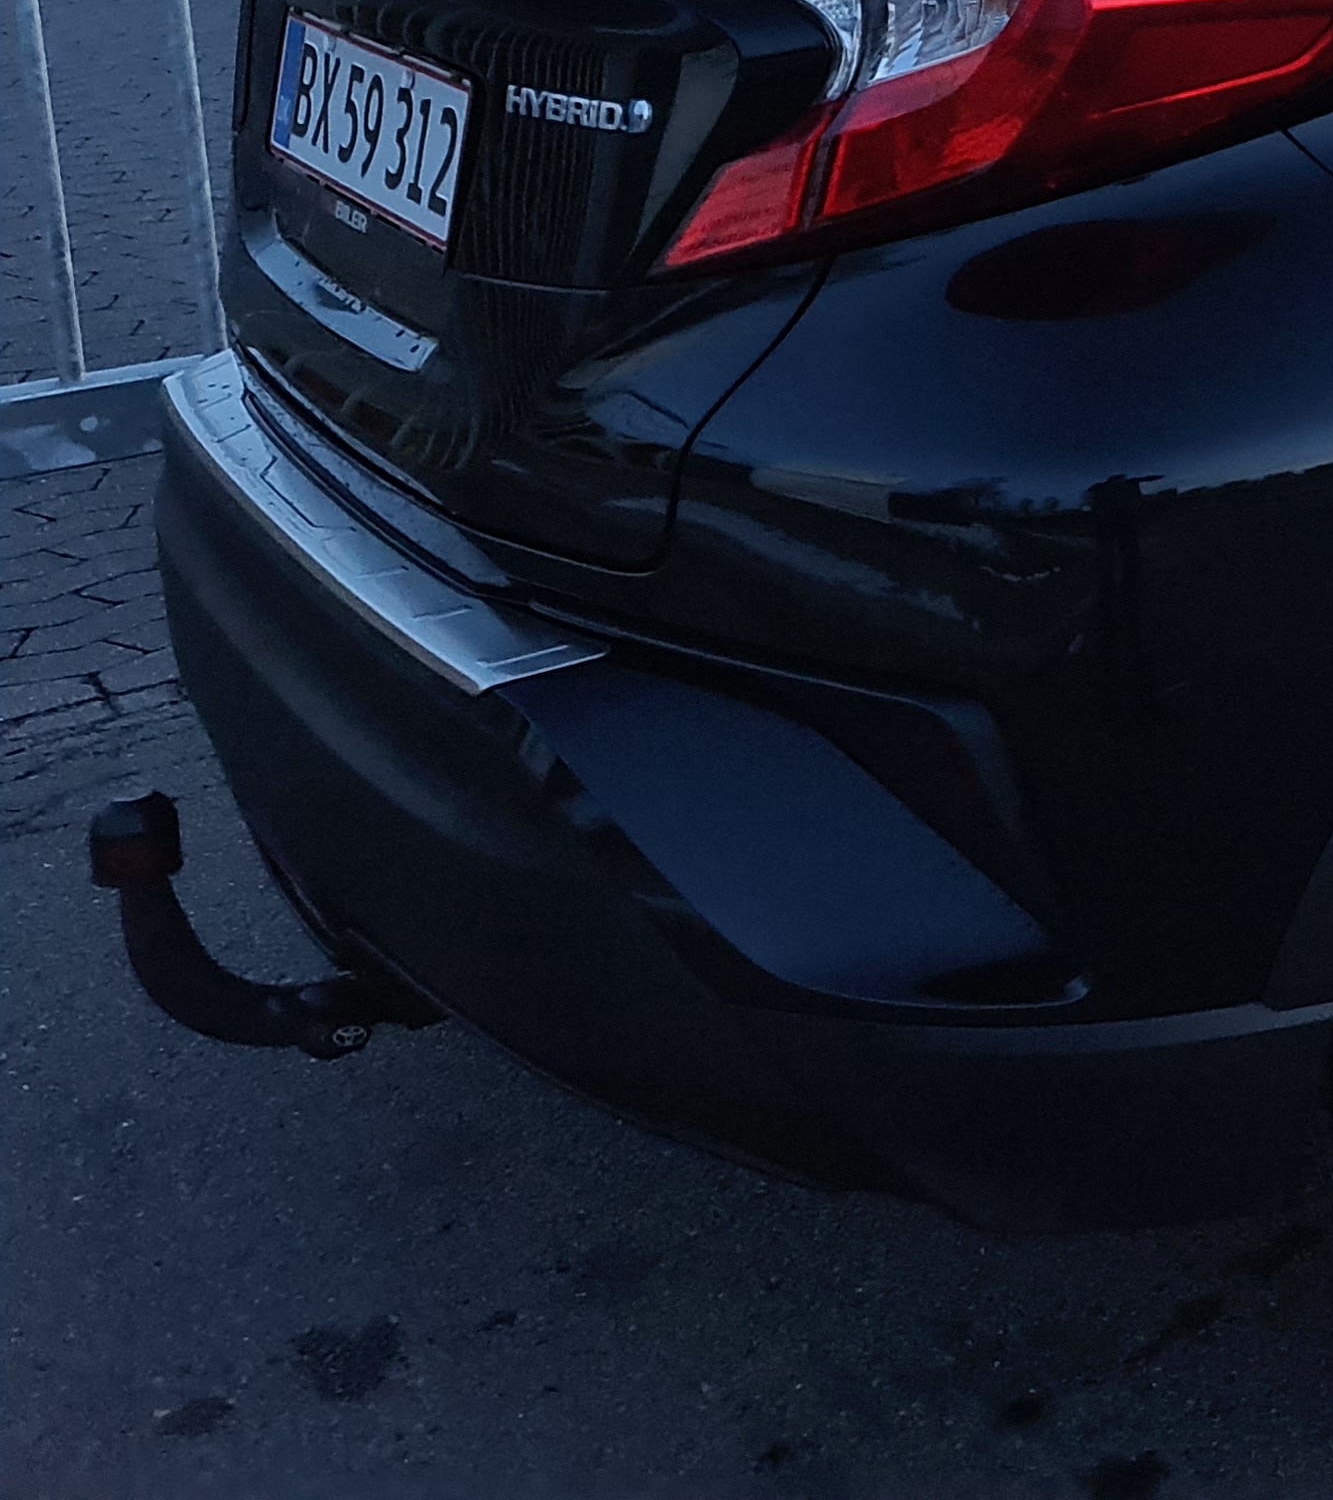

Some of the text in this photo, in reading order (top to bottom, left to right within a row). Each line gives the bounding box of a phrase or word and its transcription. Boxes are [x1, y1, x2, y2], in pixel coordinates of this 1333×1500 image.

[291, 42, 458, 218] BX 59 312
[505, 84, 623, 131] HYBRID
